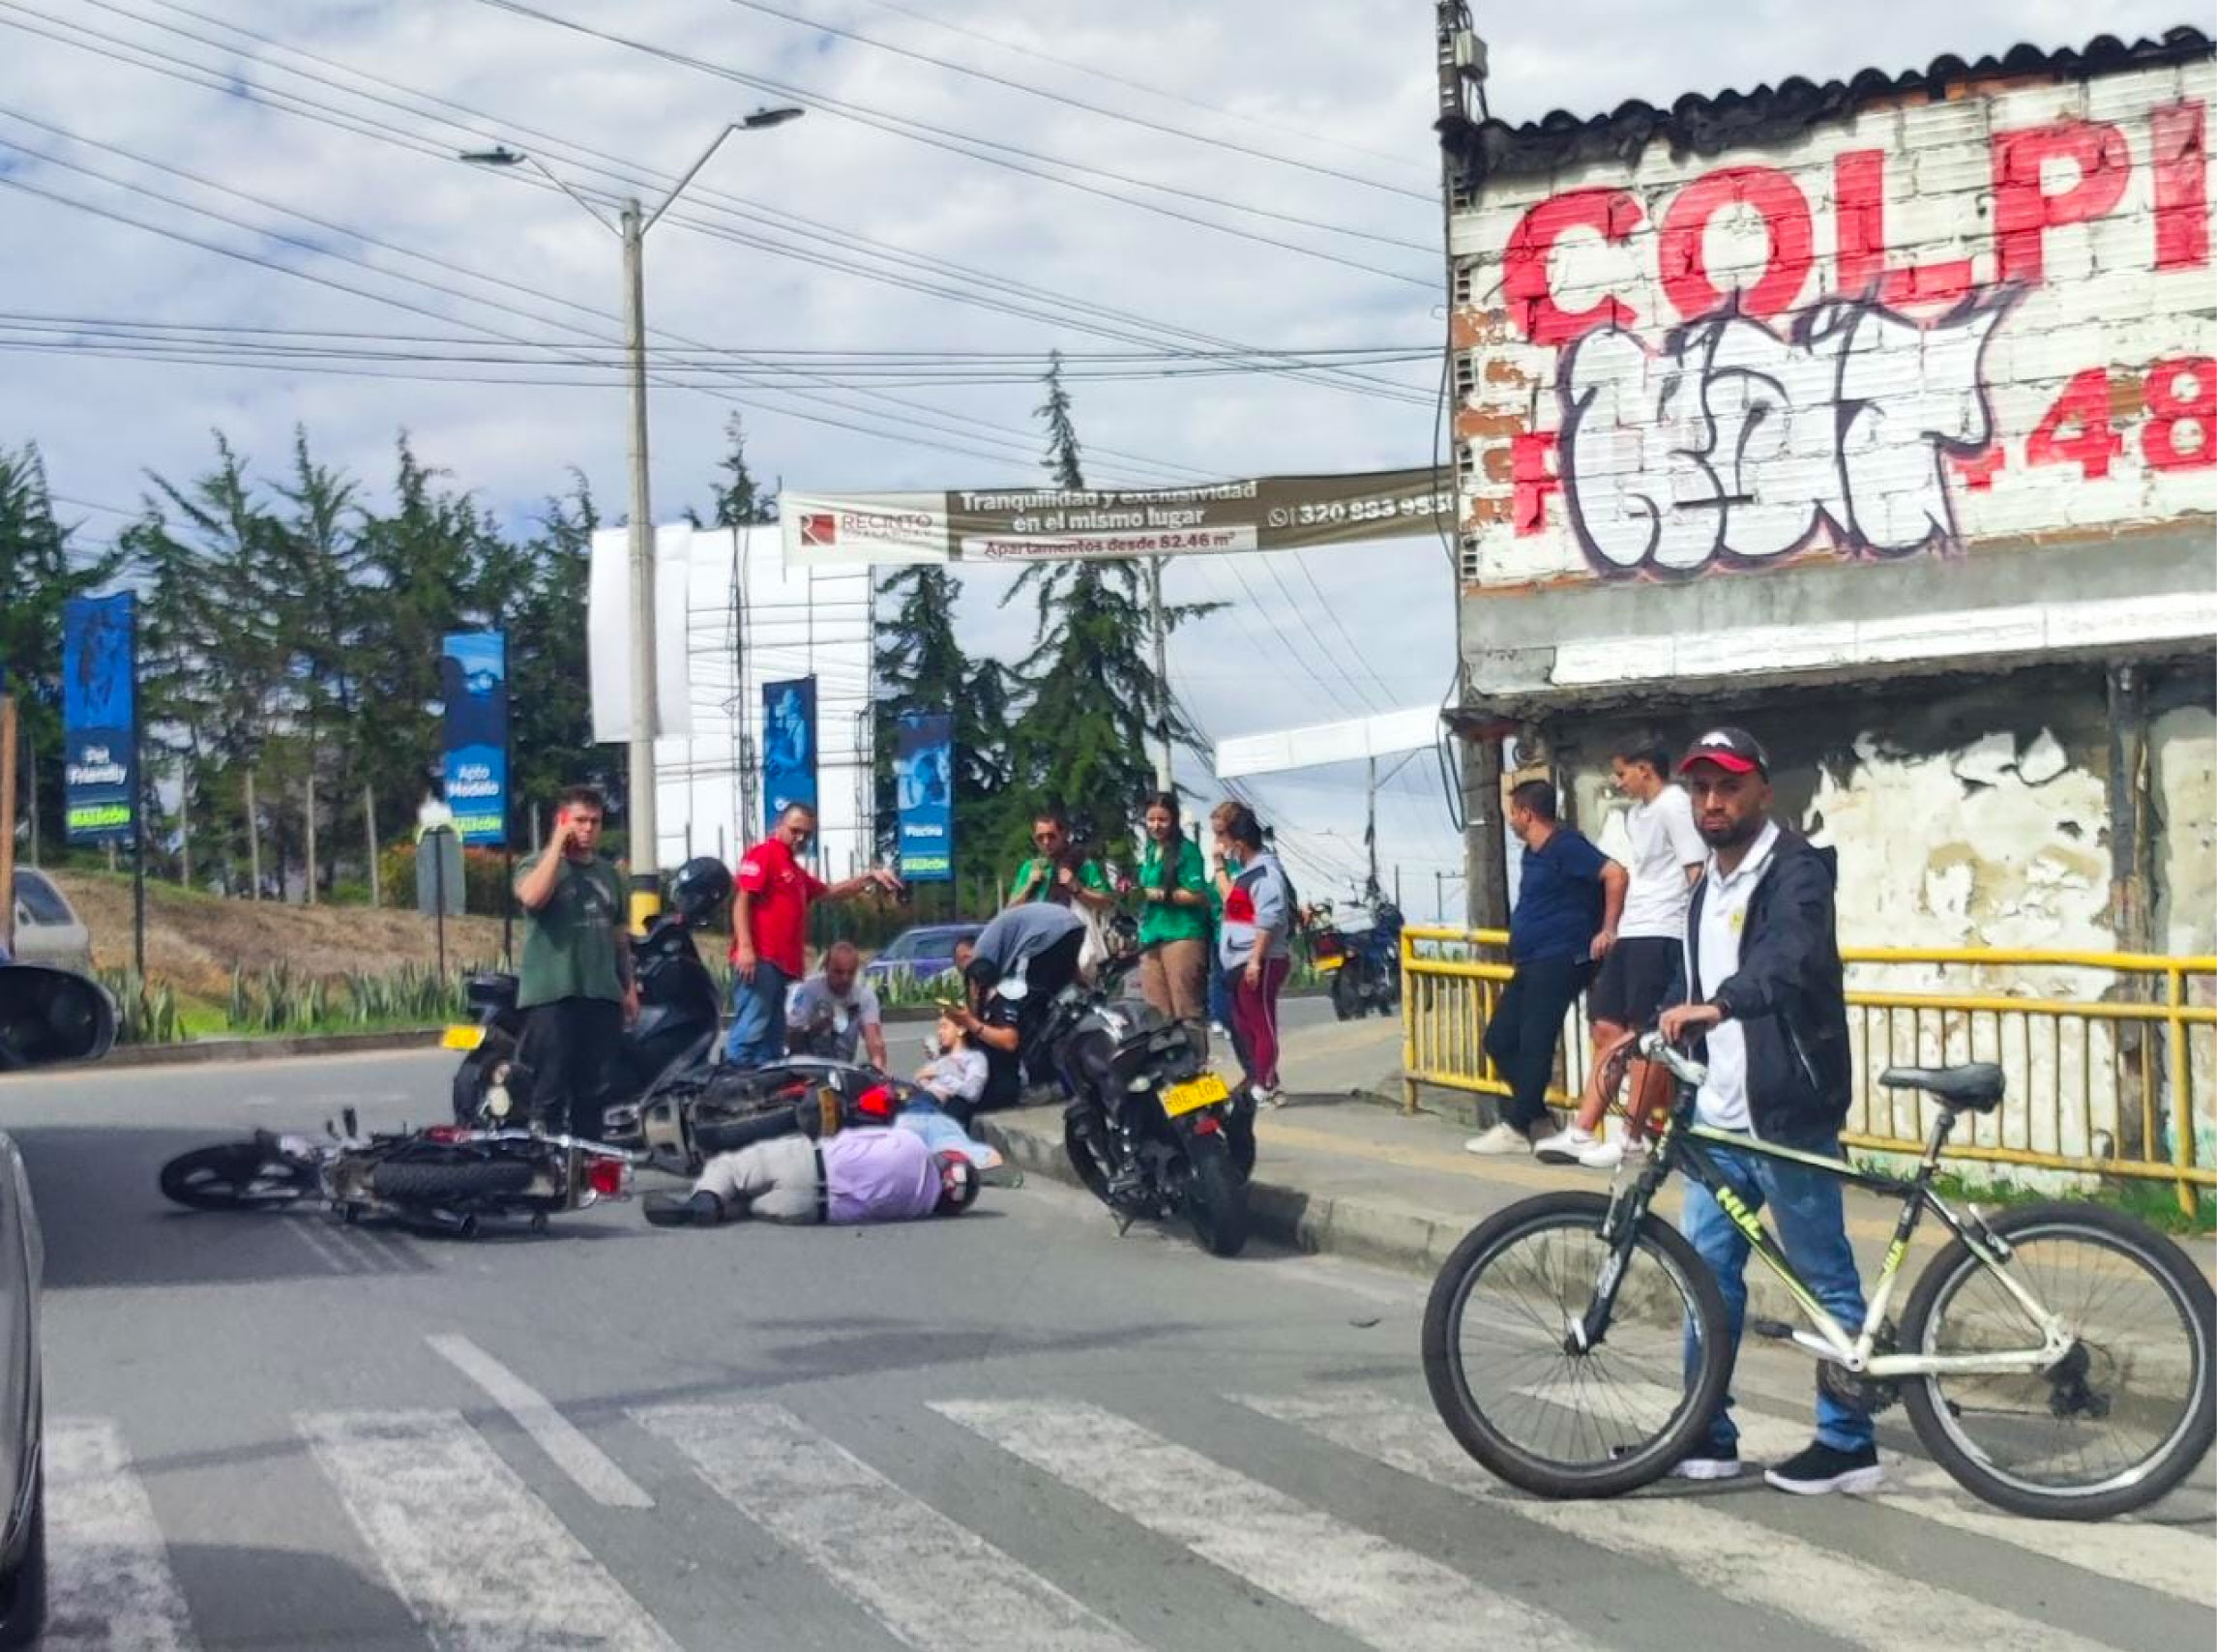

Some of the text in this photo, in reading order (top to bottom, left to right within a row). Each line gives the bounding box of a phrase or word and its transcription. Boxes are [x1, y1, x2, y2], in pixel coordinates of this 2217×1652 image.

[960, 488, 1098, 513] Tranquilidad
[1102, 493, 1115, 509] y
[1013, 505, 1206, 533] en el mismo lugar
[1298, 503, 1345, 524] 320
[985, 538, 1103, 557] Apartamentos
[1108, 536, 1155, 550] desde
